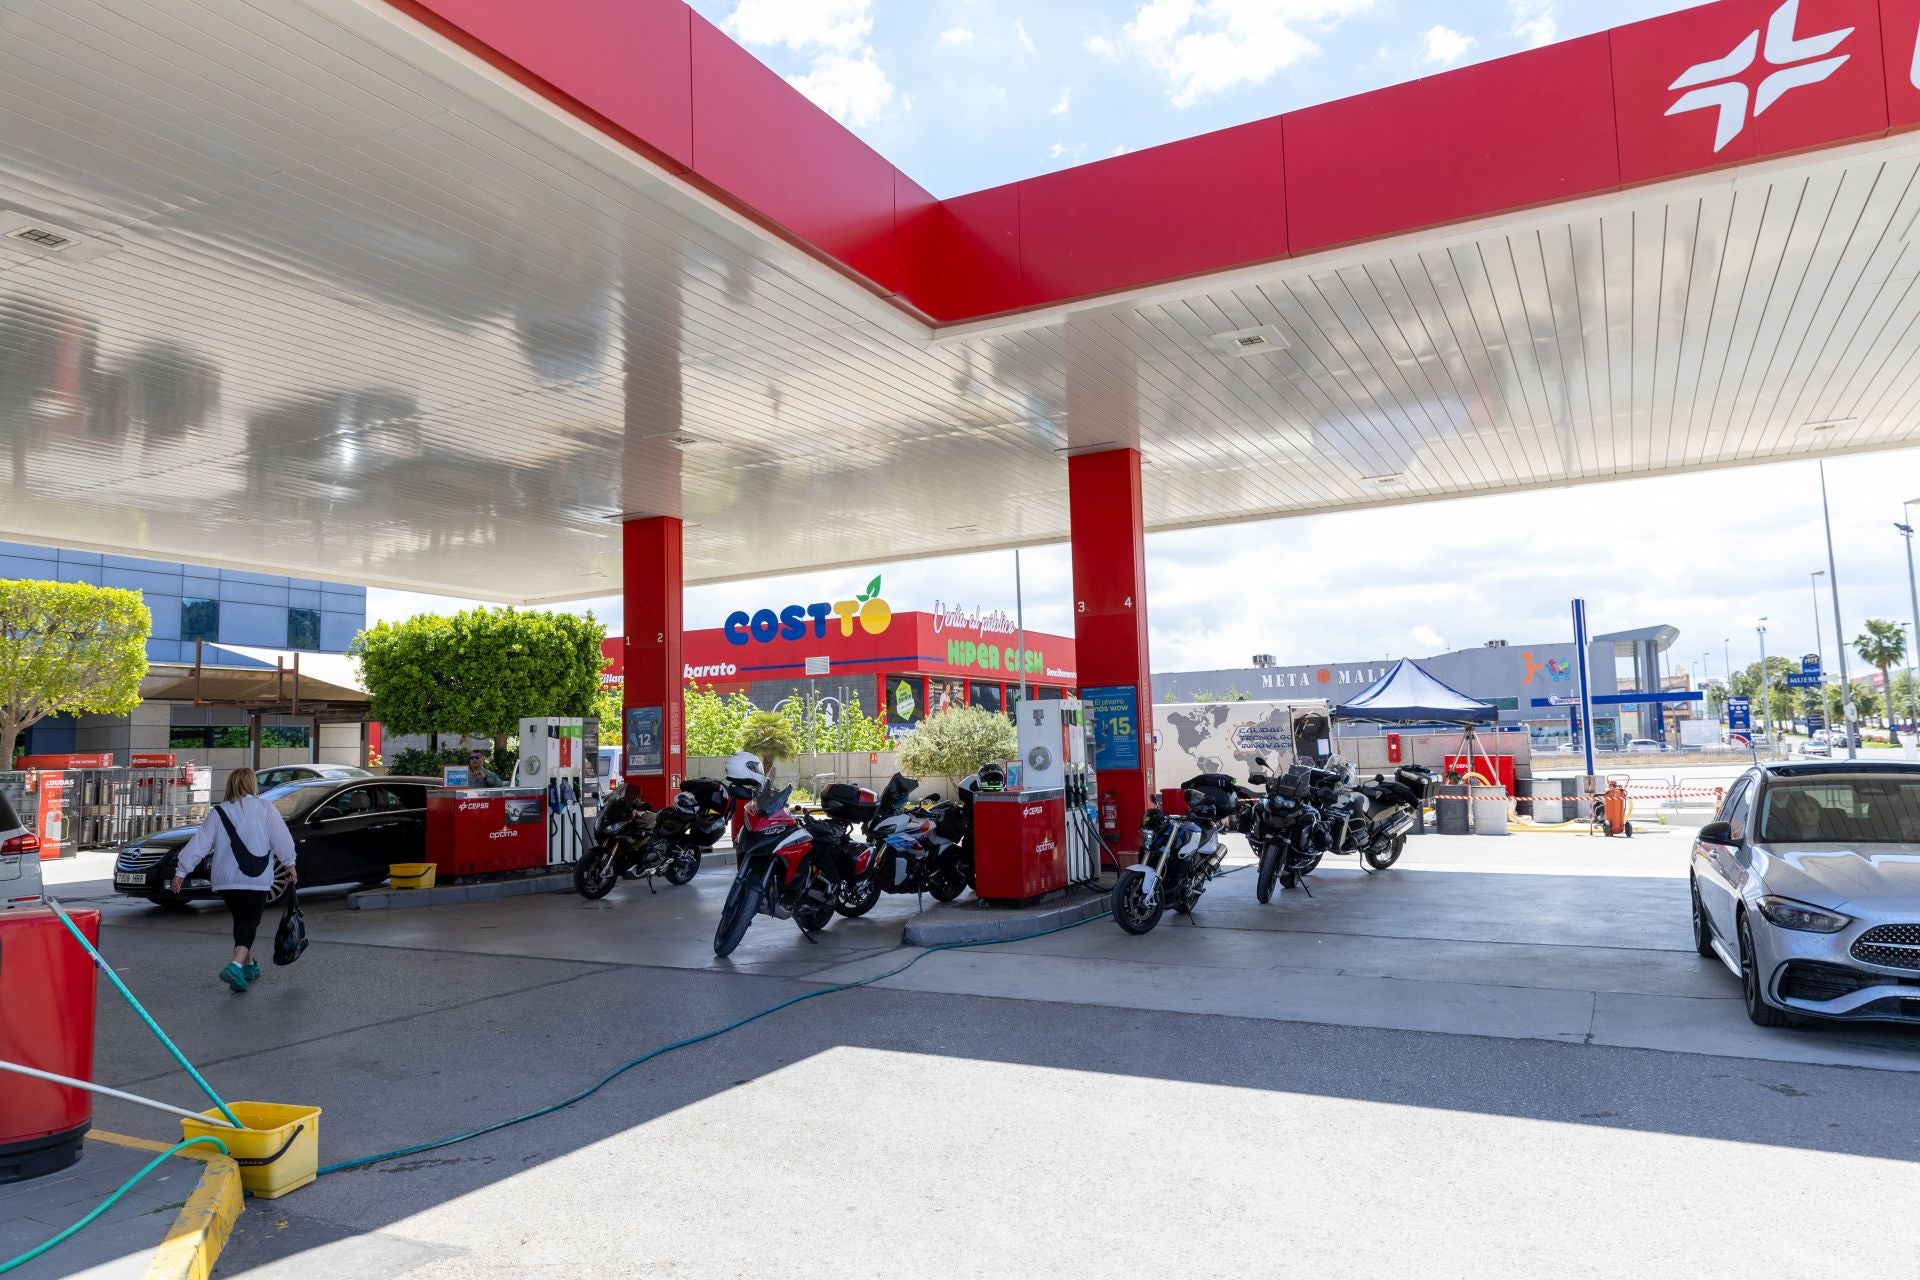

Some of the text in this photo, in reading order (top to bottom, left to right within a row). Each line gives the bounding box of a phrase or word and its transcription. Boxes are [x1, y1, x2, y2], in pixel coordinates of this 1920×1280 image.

[1078, 596, 1132, 613] 3 4
[724, 598, 892, 646] COSTTO
[934, 600, 967, 634] Venta
[625, 632, 663, 646] 1 2
[683, 662, 737, 678] barato
[1261, 672, 1310, 688] META
[1101, 698, 1125, 706] ahorro
[1109, 716, 1131, 735] 15
[638, 733, 651, 746] 12
[489, 830, 518, 840] optima
[1036, 842, 1055, 854] optima
